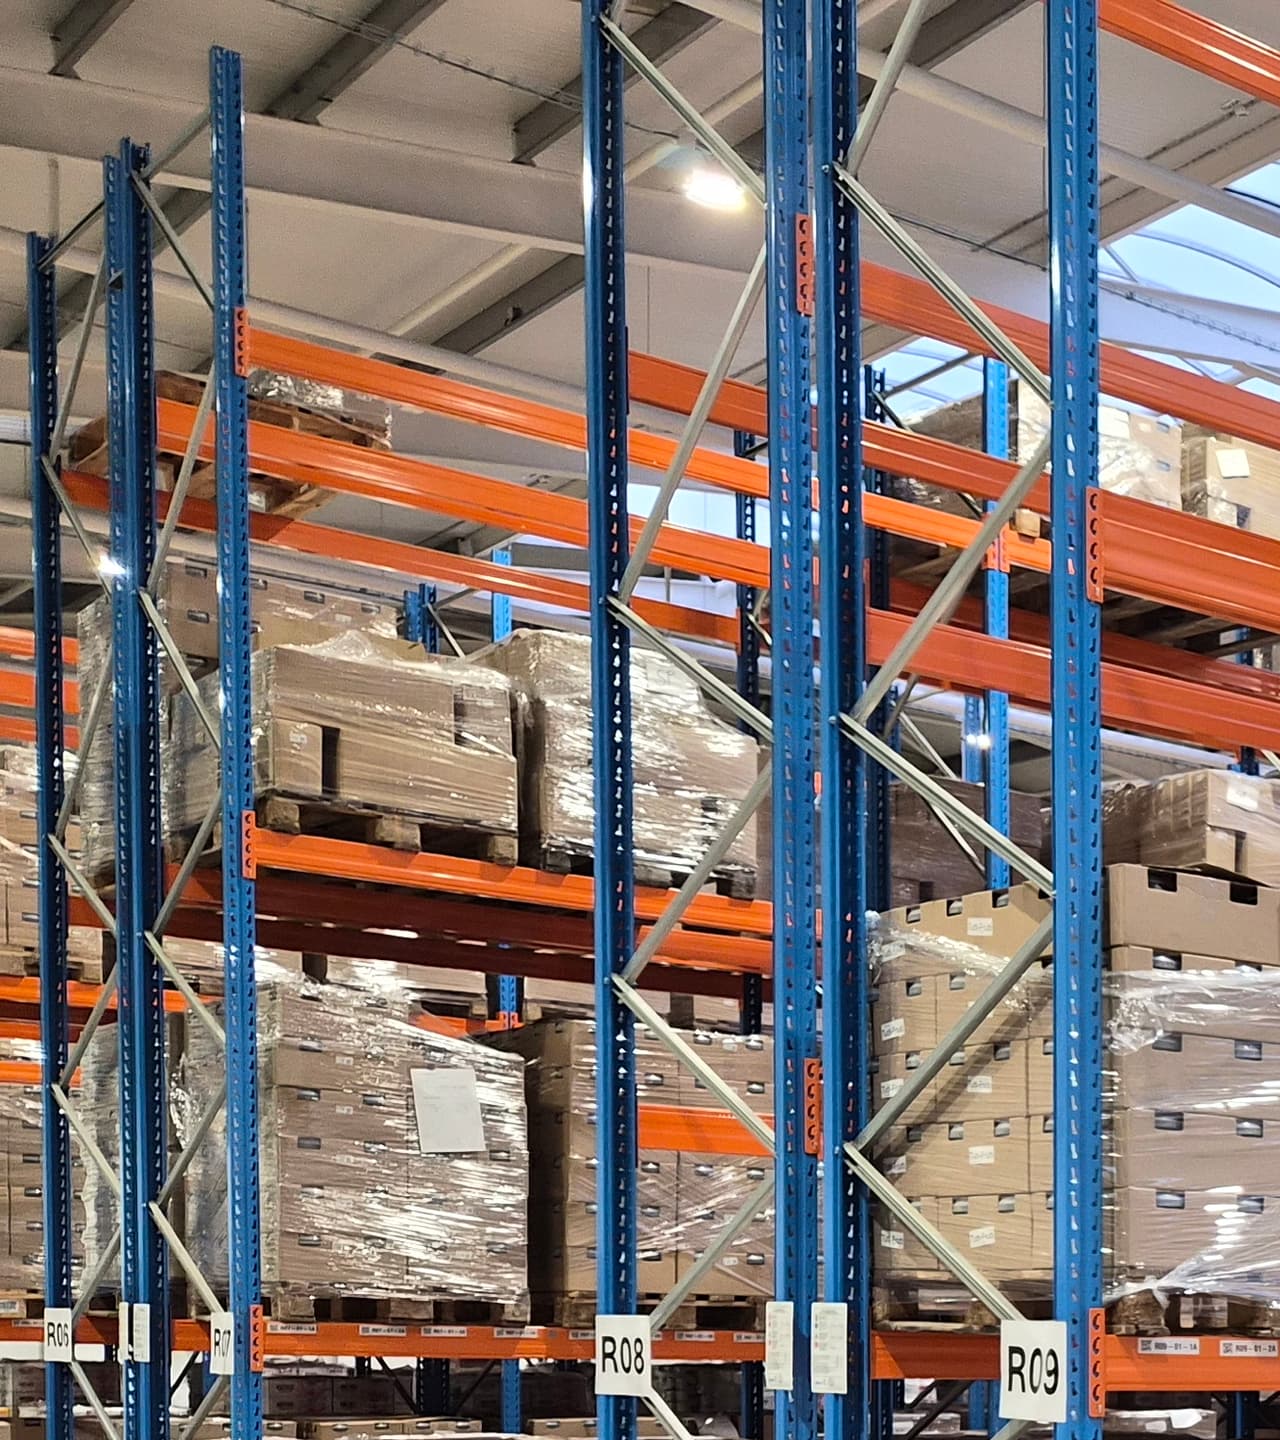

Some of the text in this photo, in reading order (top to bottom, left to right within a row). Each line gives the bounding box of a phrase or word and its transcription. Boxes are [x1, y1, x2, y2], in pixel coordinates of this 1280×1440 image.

[48, 1322, 68, 1346] R06
[215, 1329, 230, 1355] R07
[602, 1336, 644, 1374] R08
[1008, 1346, 1058, 1394] R09
